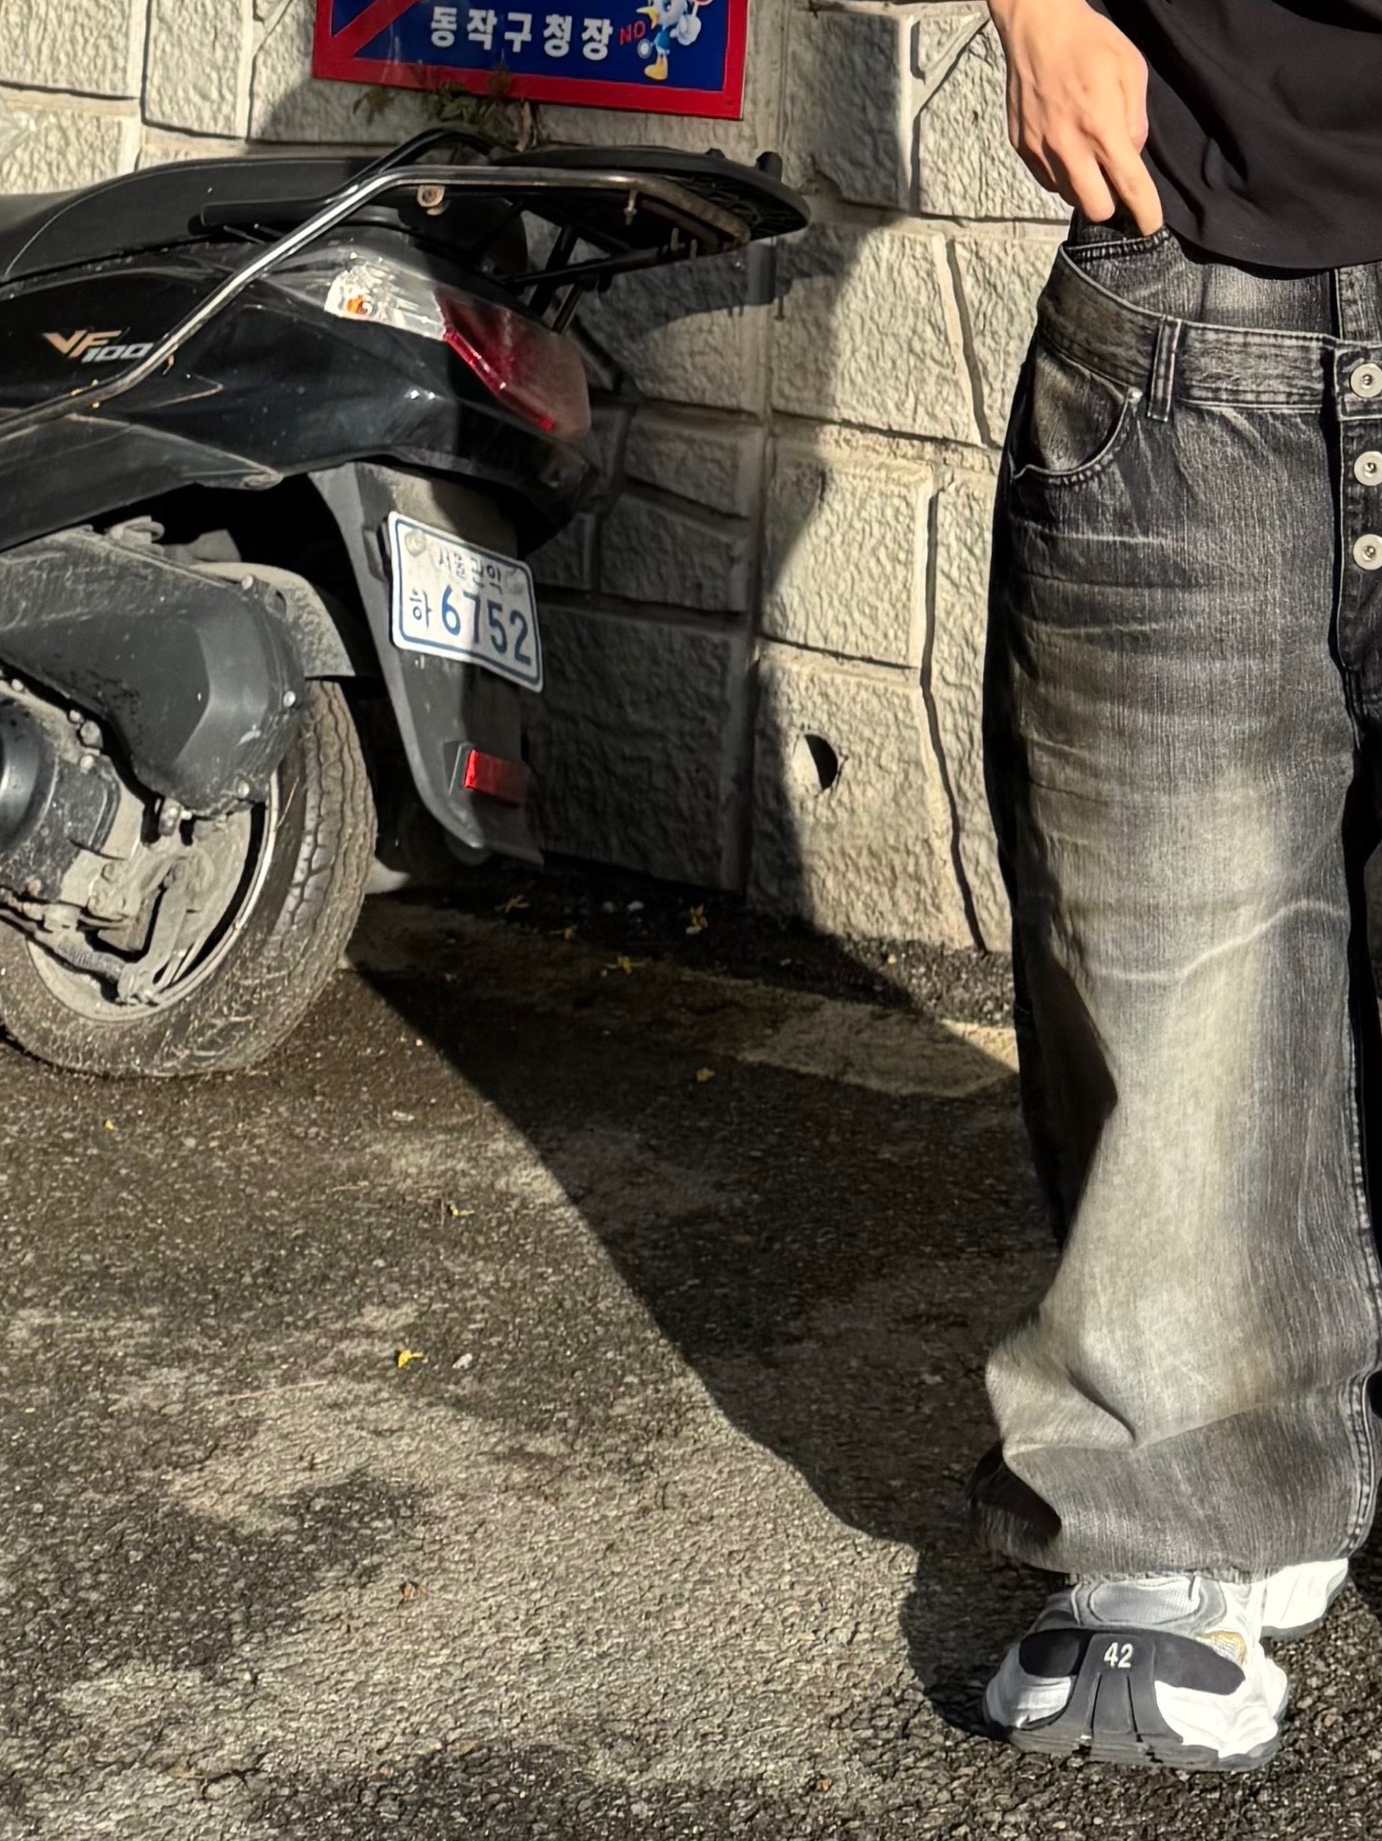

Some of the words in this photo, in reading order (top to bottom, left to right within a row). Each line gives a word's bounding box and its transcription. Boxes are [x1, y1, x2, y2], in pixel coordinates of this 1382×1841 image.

[619, 20, 646, 46] NO
[441, 584, 532, 666] 6752
[1103, 1641, 1134, 1668] 42
